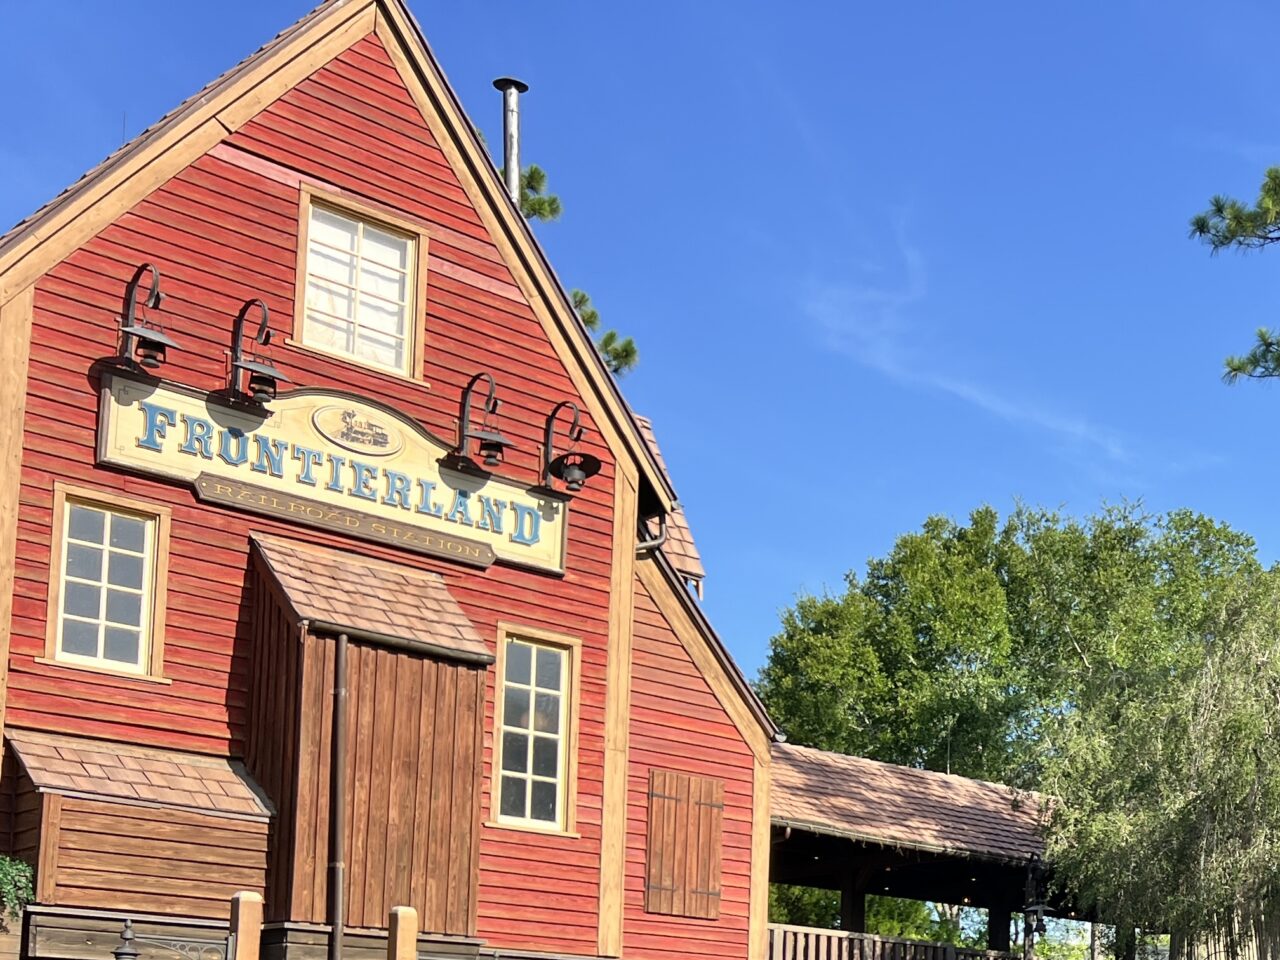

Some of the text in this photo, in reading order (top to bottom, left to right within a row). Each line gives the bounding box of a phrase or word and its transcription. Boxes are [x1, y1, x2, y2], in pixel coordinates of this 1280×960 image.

[135, 400, 541, 547] FRONTIERLAND
[214, 483, 481, 558] RAILROAD STATION
